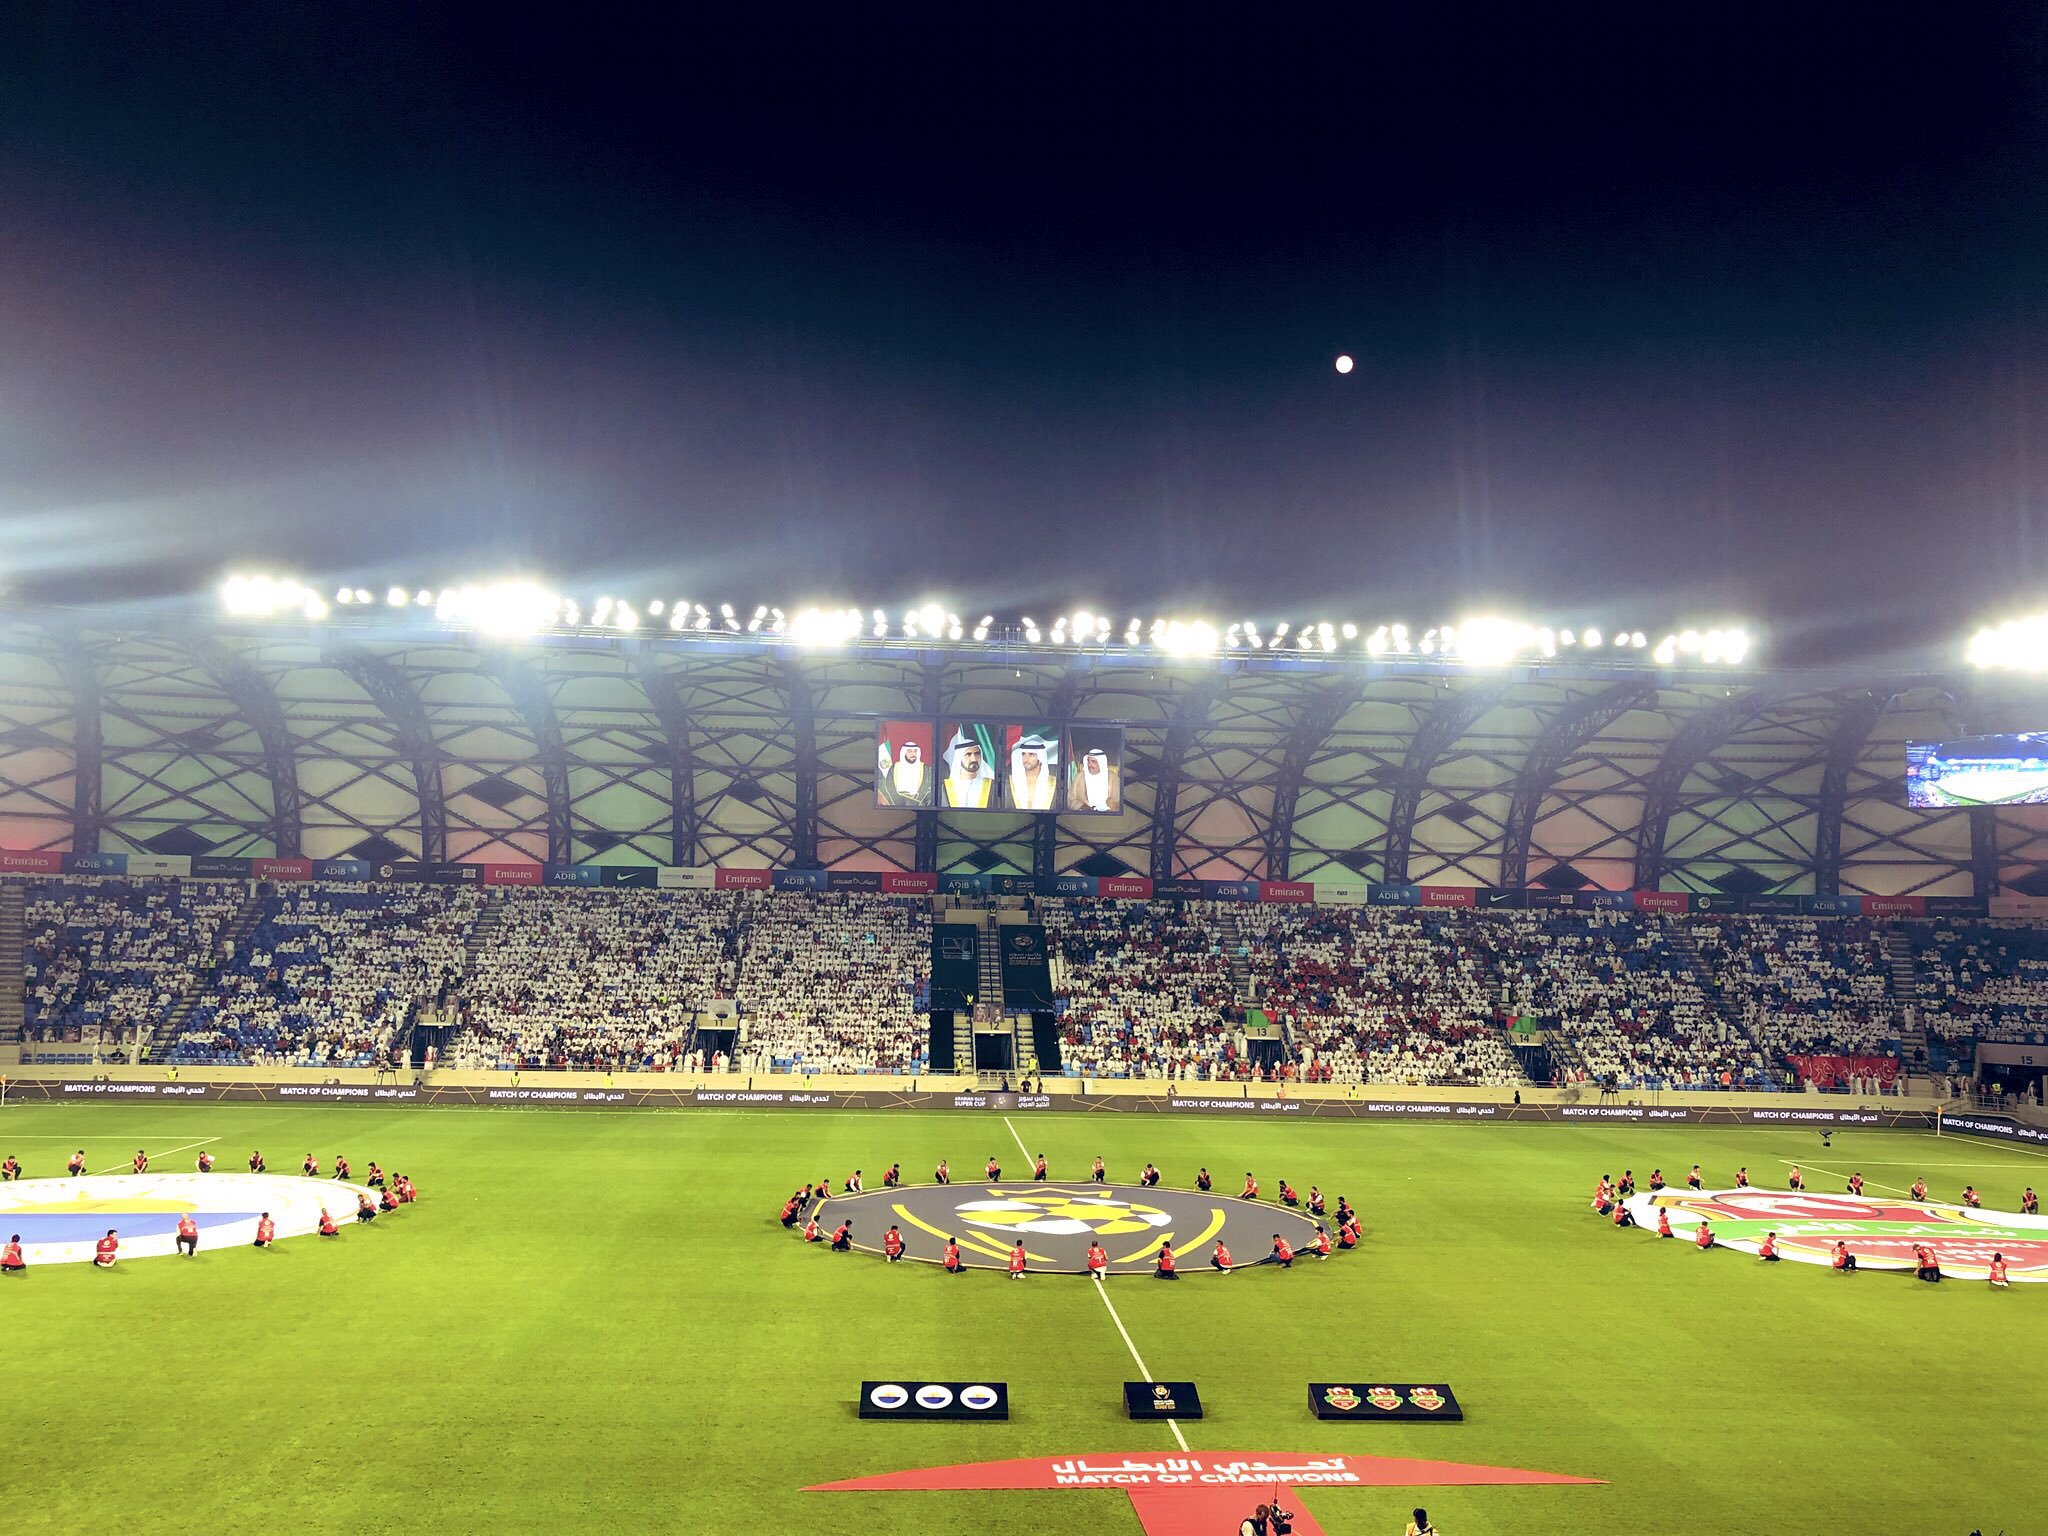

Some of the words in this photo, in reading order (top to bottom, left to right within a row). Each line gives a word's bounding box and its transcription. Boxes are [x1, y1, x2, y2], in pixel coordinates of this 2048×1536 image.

[4, 857, 48, 866] Emirates
[74, 860, 100, 868] ADIB
[263, 865, 302, 873] Emirates
[323, 867, 346, 875] ADIB
[495, 870, 533, 879] Emirates
[725, 875, 761, 883] Emirates
[892, 879, 928, 887] Emirates
[1108, 884, 1143, 892] Emirates
[1269, 888, 1304, 896] Emirates
[1430, 892, 1465, 900] Emirates
[1643, 898, 1678, 906] Emirates
[1813, 902, 1836, 910] ADIB
[1872, 902, 1912, 910] Emirates
[435, 1014, 446, 1023] 10
[990, 1022, 999, 1030] 12
[1257, 1028, 1267, 1036] 13
[1519, 1034, 1529, 1043] 14
[2020, 1056, 2033, 1065] 15
[108, 1085, 155, 1093] CHAMPIONS
[163, 1086, 185, 1095] الأبطال
[186, 1087, 205, 1095] تحدي
[322, 1088, 368, 1096] CHAMPIONS
[375, 1089, 397, 1097] الأبطال
[398, 1090, 416, 1098] تحدي
[584, 1093, 606, 1101] الأبطال
[738, 1094, 783, 1102] CHAMPIONS
[1282, 1103, 1300, 1111] تحدي
[1407, 1105, 1451, 1113] CHAMPIONS
[1477, 1107, 1495, 1115] تحدي
[1601, 1109, 1643, 1117] CHAMPIONS
[1791, 1112, 1834, 1120] CHAMPIONS
[1861, 1114, 1878, 1122] تحدي
[1942, 1118, 1964, 1127] MATCH
[1974, 1122, 2013, 1134] CHAMPIONS
[2017, 1129, 2037, 1138] الأبطال
[1056, 1474, 1150, 1483] MATCH
[1157, 1474, 1193, 1483] OF
[1200, 1473, 1360, 1483] CHAMPIONS
